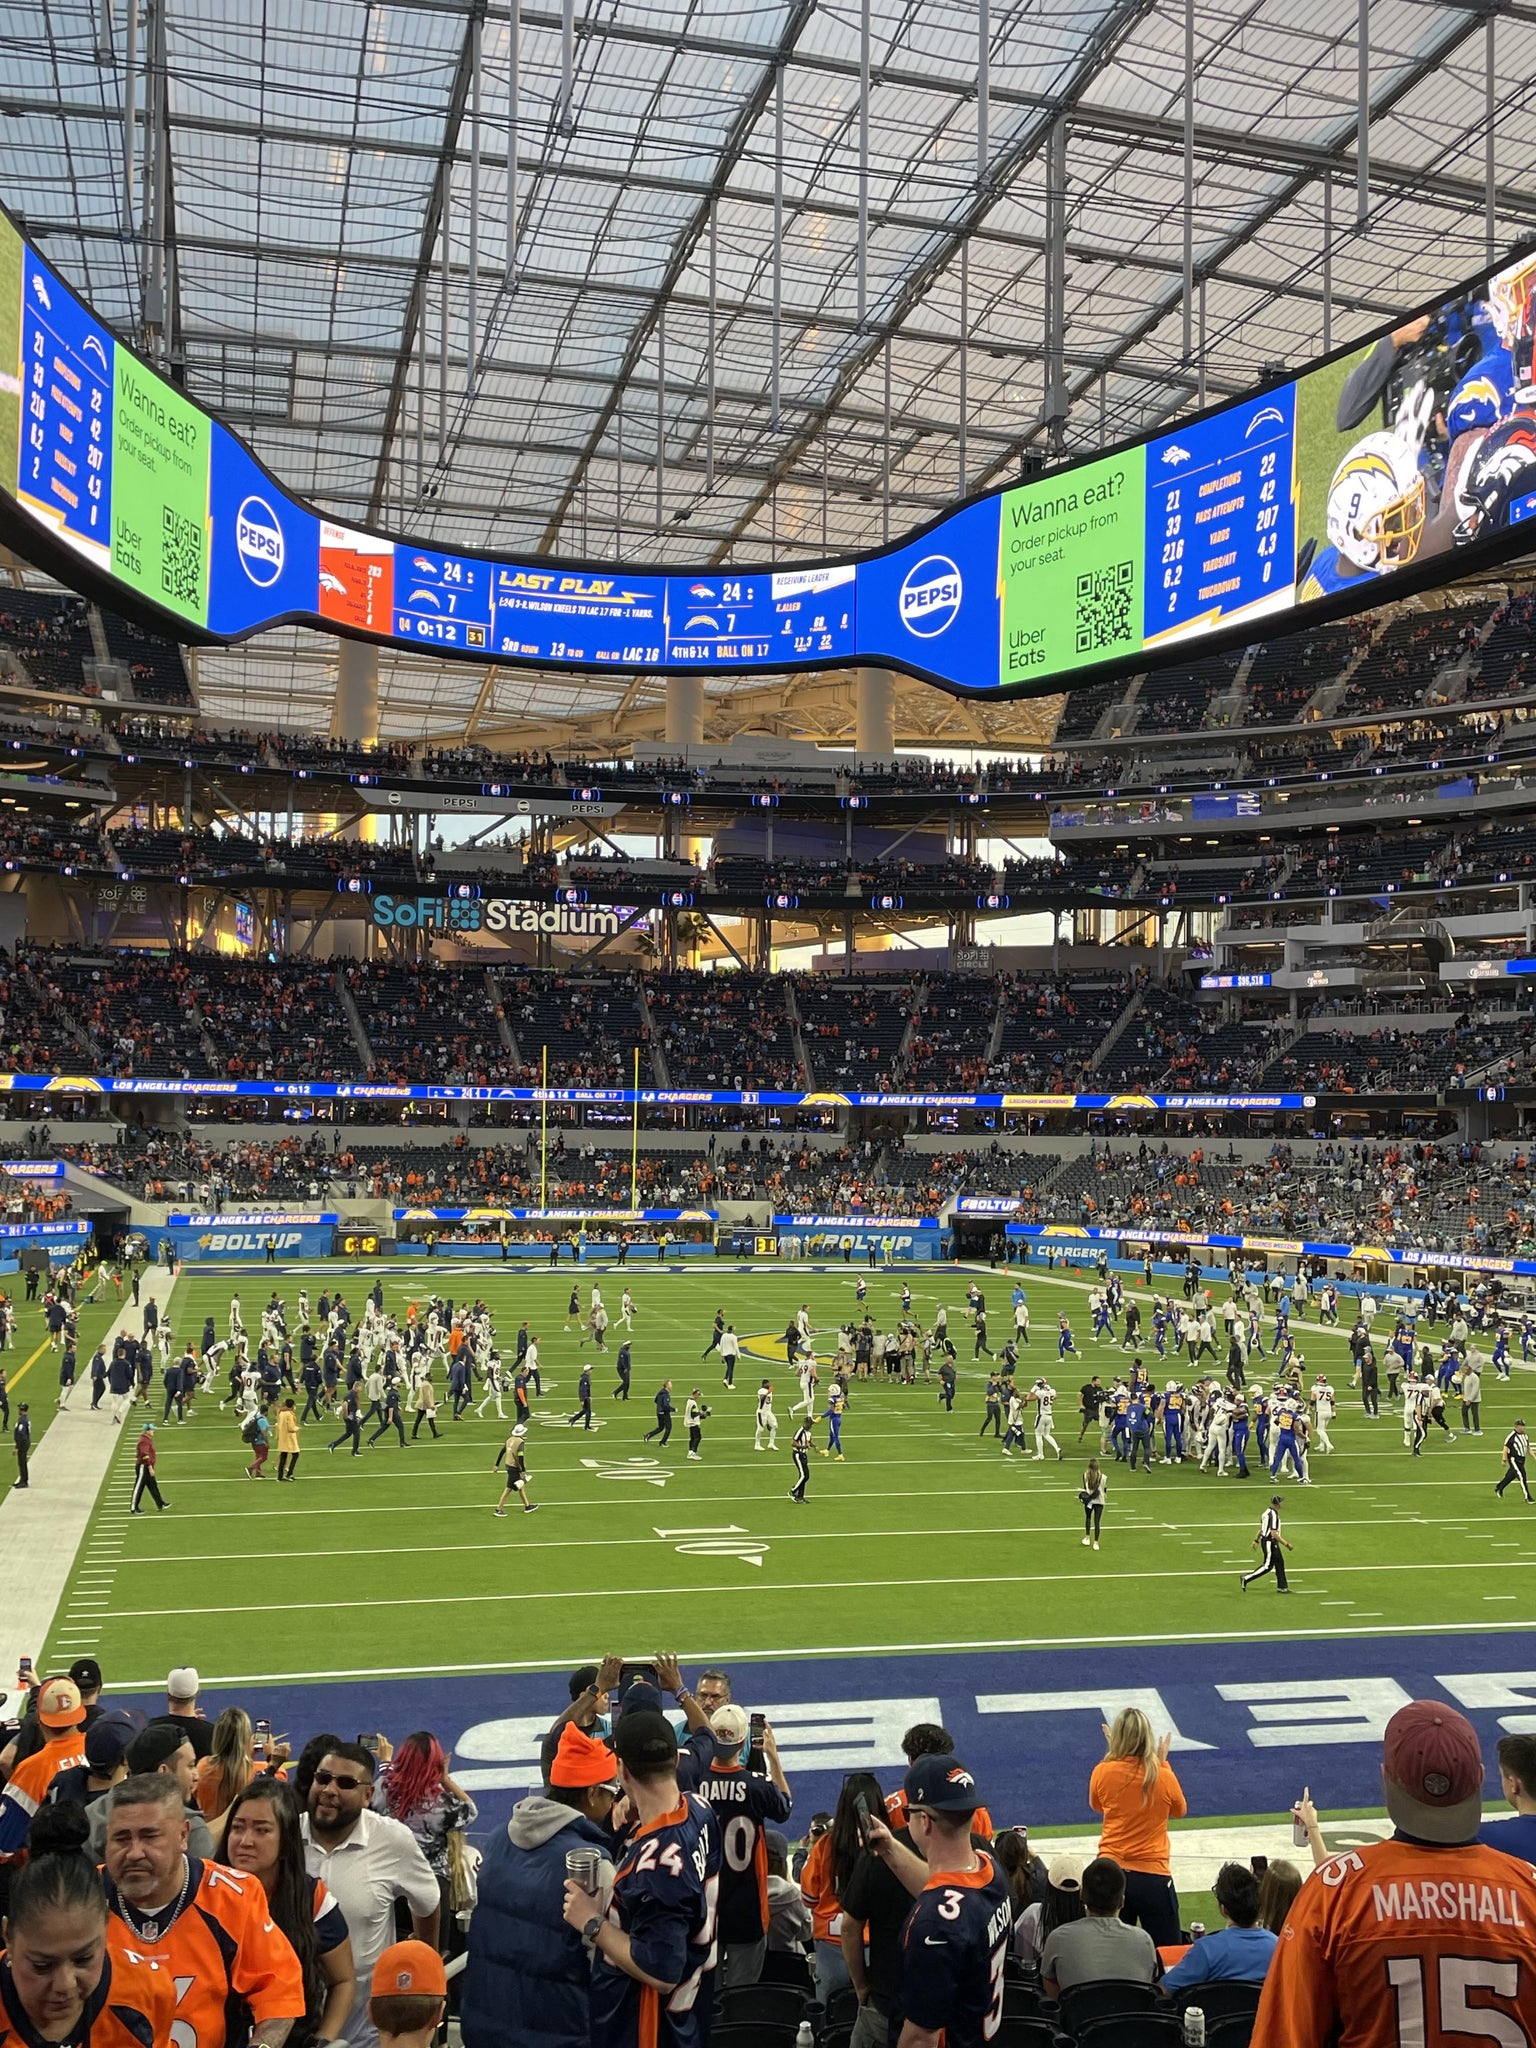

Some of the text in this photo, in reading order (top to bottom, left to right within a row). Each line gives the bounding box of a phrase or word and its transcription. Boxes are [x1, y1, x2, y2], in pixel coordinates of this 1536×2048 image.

[90, 388, 102, 413] 22
[120, 368, 165, 429] Wanna
[169, 416, 197, 450] eat?
[90, 418, 101, 442] 42
[118, 434, 156, 473] your seat.
[119, 409, 192, 476] Order pickup from
[33, 456, 39, 479] 2
[1260, 452, 1276, 477] 22
[1011, 471, 1125, 529] Wanna eat?
[1166, 489, 1180, 512] 21
[1260, 479, 1276, 503] 42
[1166, 514, 1181, 537] 33
[1256, 505, 1279, 532] 207
[117, 516, 142, 551] Uber
[240, 523, 280, 560] PEPSI
[1011, 511, 1119, 554] Order pickup from
[1162, 539, 1184, 564] 216
[1257, 532, 1277, 557] 4.3
[116, 541, 142, 575] Eats
[1010, 547, 1066, 577] your seat.
[443, 561, 462, 583] 24
[499, 571, 615, 595] LAST PLAY
[776, 572, 830, 586] RECEIVING LEADER
[1163, 565, 1182, 589] 6.2
[1263, 561, 1271, 583] 0
[722, 582, 741, 601] 24
[904, 582, 958, 610] PEPSI
[1168, 592, 1177, 612] 2
[447, 594, 457, 613] 7
[586, 605, 599, 616] LAC
[599, 607, 608, 617] 17
[417, 620, 457, 641] 0:12
[468, 631, 483, 642] 31
[726, 613, 736, 632] 7
[1009, 627, 1046, 649] Uber
[550, 642, 566, 657] 13
[622, 647, 643, 661] LAC
[644, 648, 659, 662] 16
[716, 646, 739, 658] BALL
[741, 644, 754, 657] ON
[757, 644, 769, 657] 17
[1008, 647, 1046, 670] Eats
[443, 798, 477, 808] PEPSI
[571, 804, 604, 814] PEPSI
[373, 895, 618, 934] SoFi Stadium
[957, 960, 989, 968] CIRCLE
[113, 1081, 237, 1093] LOS ANGELES CHARGERS
[288, 1086, 311, 1094] 0:12
[337, 1087, 411, 1097] LA CHARGERS
[557, 1091, 569, 1099] 14
[641, 1092, 654, 1101] LA
[657, 1093, 712, 1102] CHARGERS
[860, 1096, 976, 1106] LOS ANGELES CHARGERS
[1166, 1098, 1281, 1108] LOS ANGELES CHARGERS
[190, 1215, 321, 1226] LOS ANGELES CHARGERS
[793, 1216, 920, 1227] LOS ANGELES CHARGERS
[1100, 1229, 1209, 1244] LOS ANGELES CHARGERS
[1402, 1251, 1514, 1270] LOS ANGELES CHARGERS
[700, 1781, 747, 1802] DAVIS
[636, 1838, 683, 1877] 24
[938, 1890, 965, 1920] 3
[1372, 1881, 1525, 1928] MARSHALL
[1385, 1954, 1529, 2048] 15
